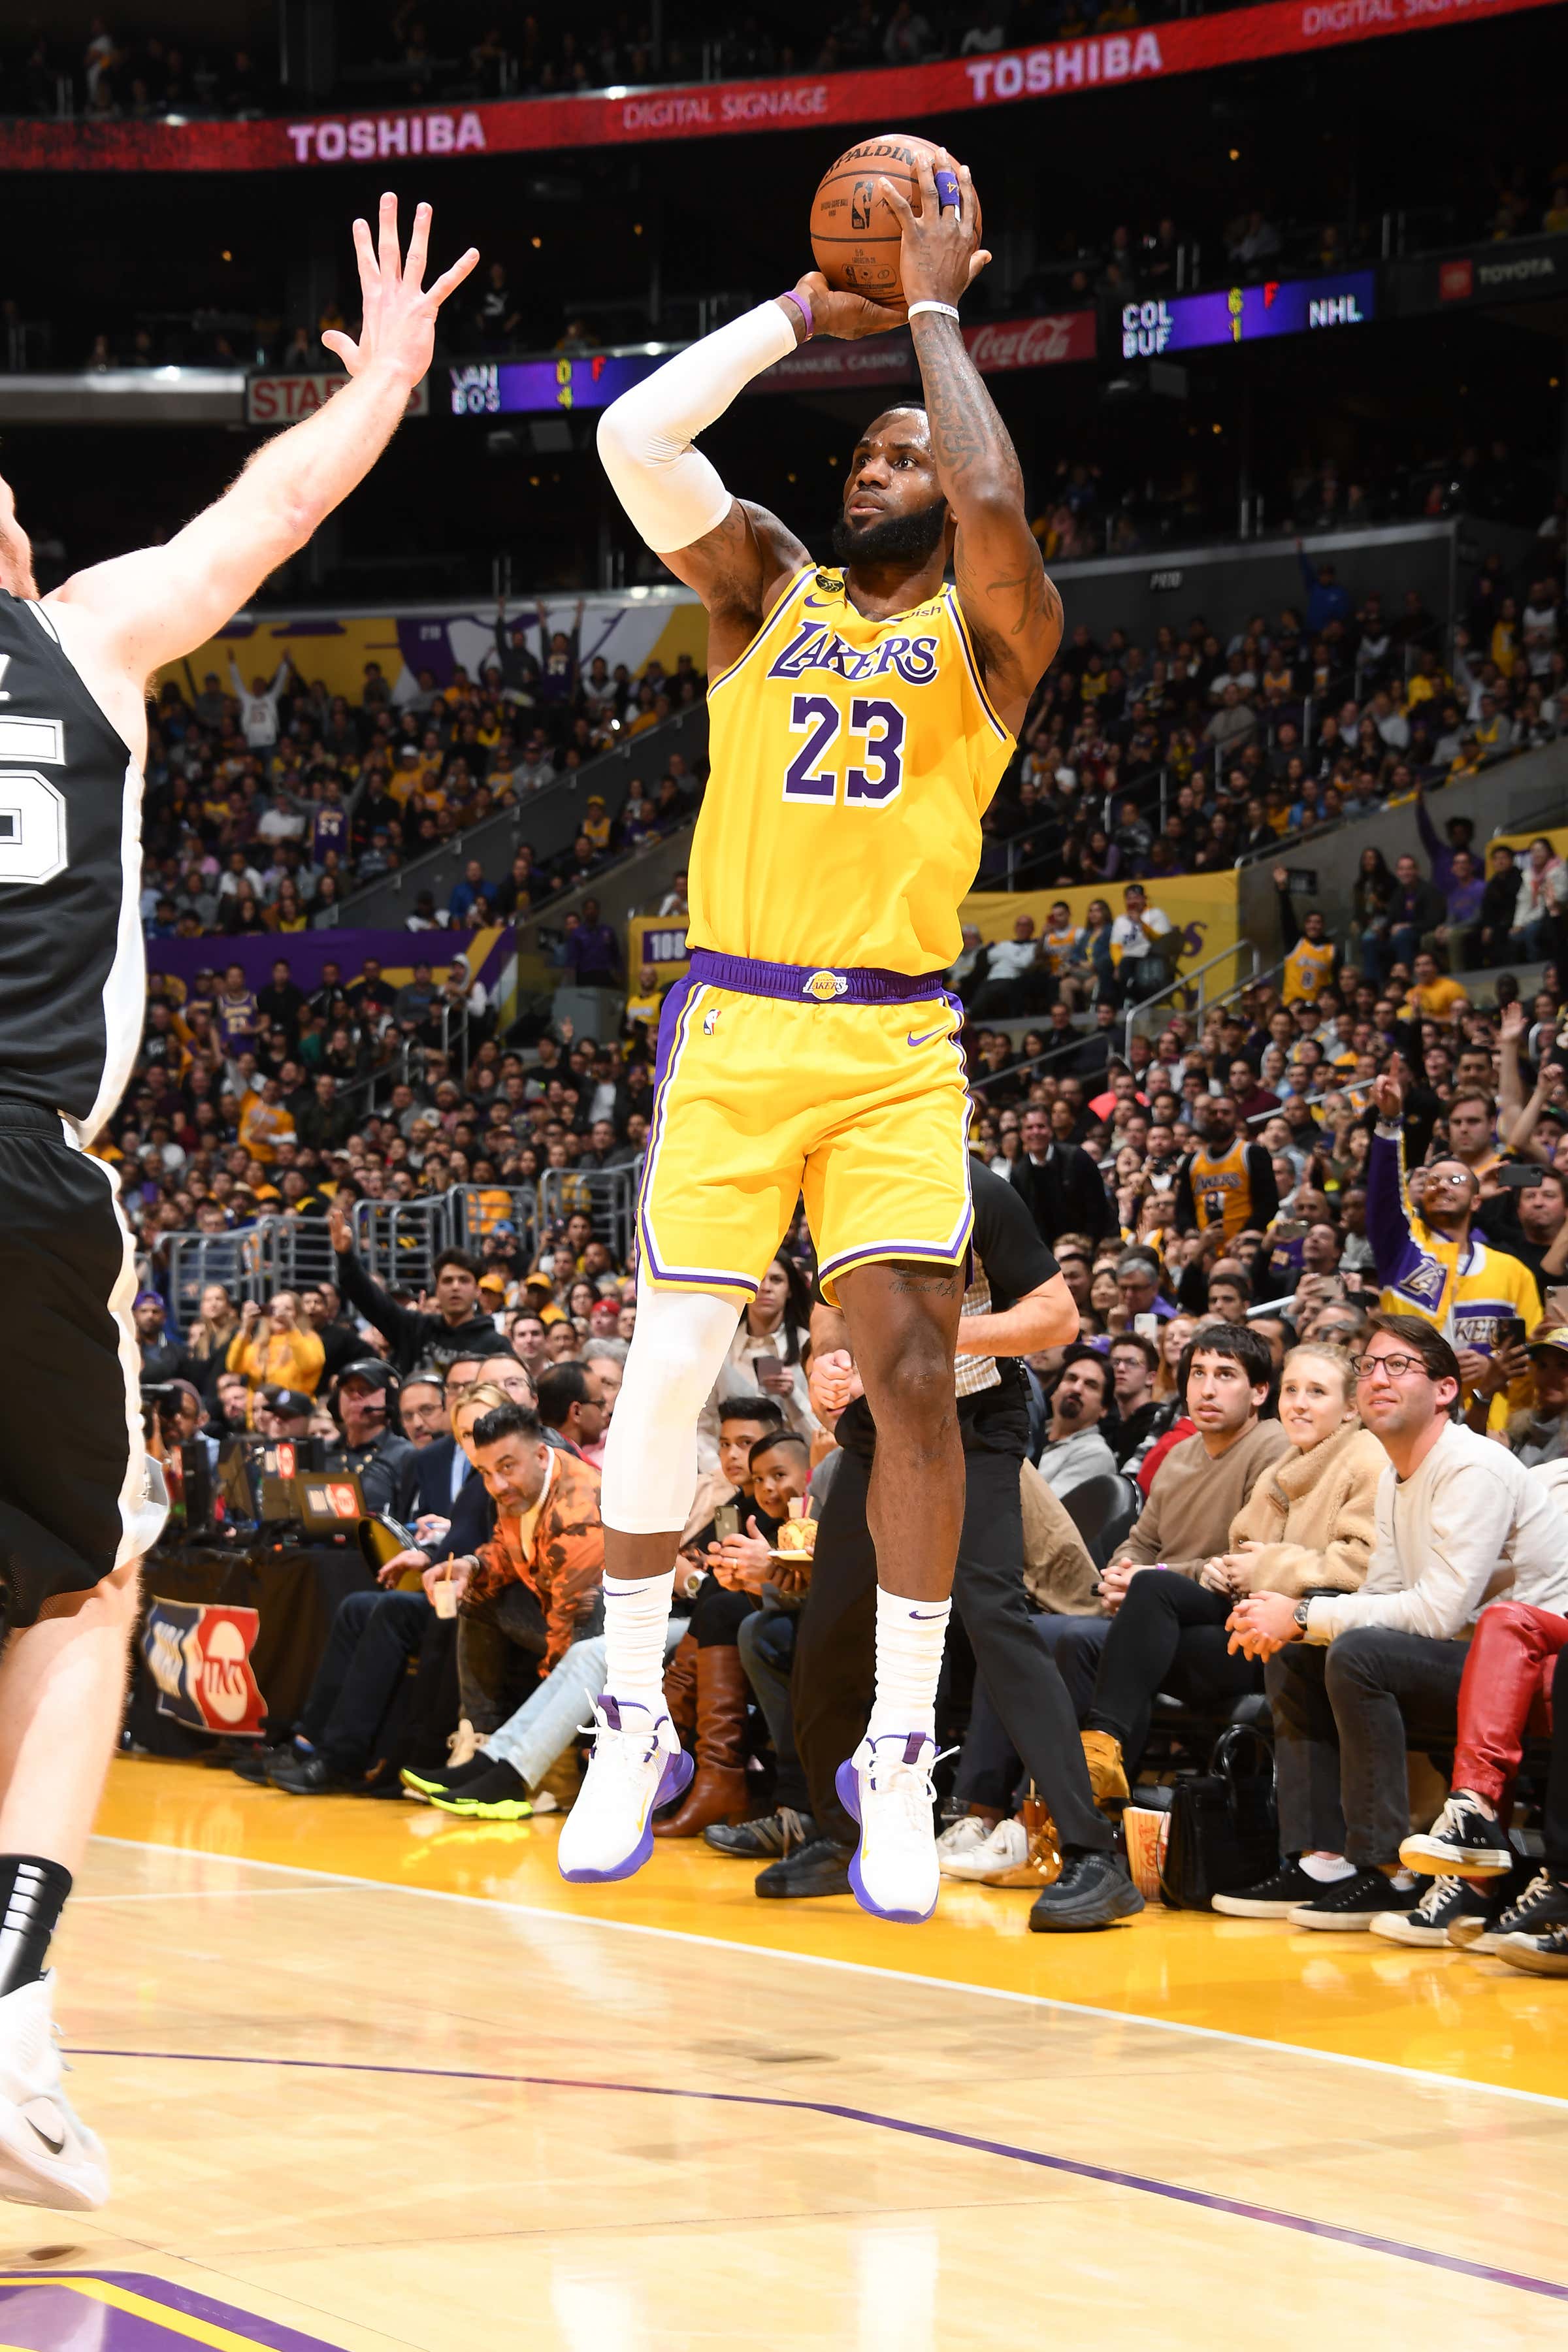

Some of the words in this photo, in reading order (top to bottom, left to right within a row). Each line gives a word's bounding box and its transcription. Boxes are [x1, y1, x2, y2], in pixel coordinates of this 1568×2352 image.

[966, 32, 1163, 101] TOSHIBA
[623, 97, 714, 129] DIGITAL
[721, 86, 827, 121] SIGNAGE
[287, 113, 485, 162] TOSHIBA
[1478, 259, 1555, 285] TOYOTA
[1122, 301, 1173, 331] COL
[1264, 282, 1279, 309] F
[1309, 293, 1364, 328] NHL
[1122, 326, 1171, 359] BUF
[557, 359, 572, 384] 0
[592, 356, 606, 382] F
[780, 357, 841, 374] MANUEL
[845, 352, 907, 370] CASINO
[451, 387, 500, 415] BOS
[767, 620, 940, 686] LAKERS
[782, 693, 907, 808] 23
[804, 979, 847, 993] LAKERS
